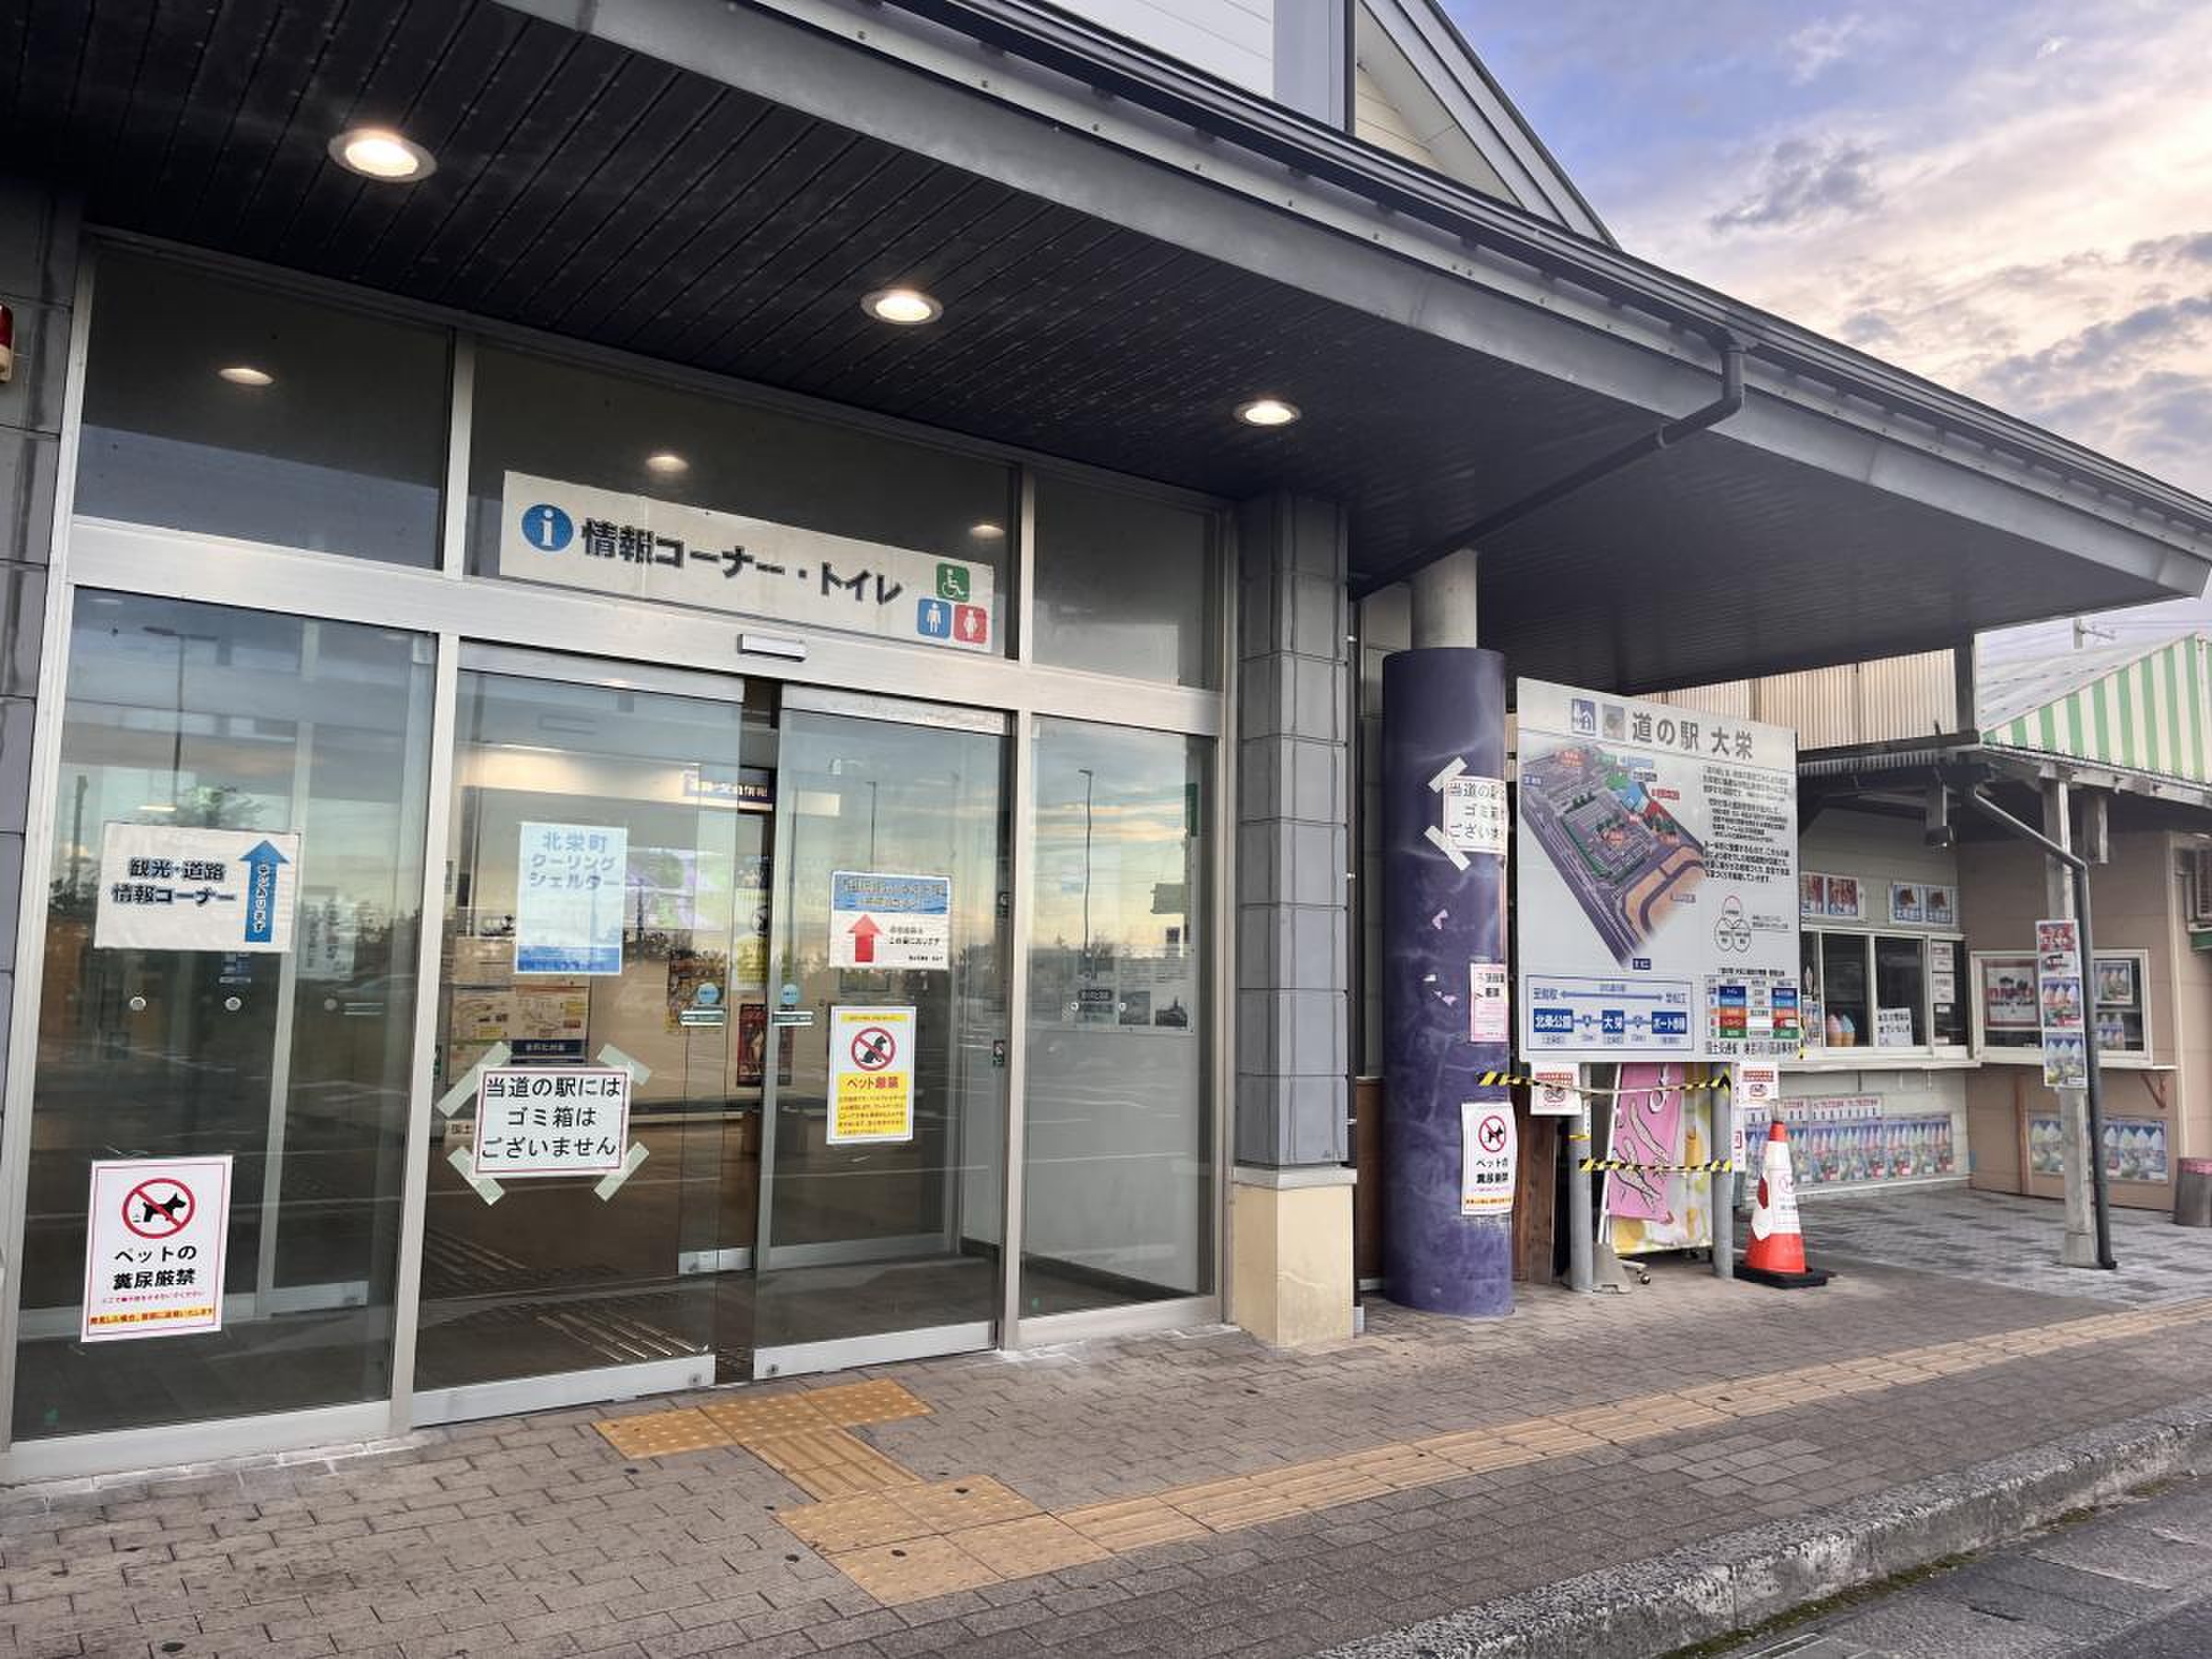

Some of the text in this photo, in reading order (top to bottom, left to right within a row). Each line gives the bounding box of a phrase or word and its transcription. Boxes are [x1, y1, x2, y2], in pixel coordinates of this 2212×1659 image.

[581, 516, 903, 606] 情報コーナー・トイレ
[1632, 712, 1753, 759] 道の駅 大栄
[543, 831, 608, 854] 北栄町
[129, 858, 225, 881] 観光・道路
[530, 853, 616, 871] クーリング
[529, 872, 620, 890] シェルター
[112, 882, 237, 906] 情報コーナー
[486, 1077, 620, 1099] 当道の駅には
[507, 1106, 596, 1128] ゴミ箱は
[481, 1135, 617, 1159] ございません
[114, 1245, 197, 1264] ペットの
[112, 1267, 196, 1291] 糞尿厳禁
